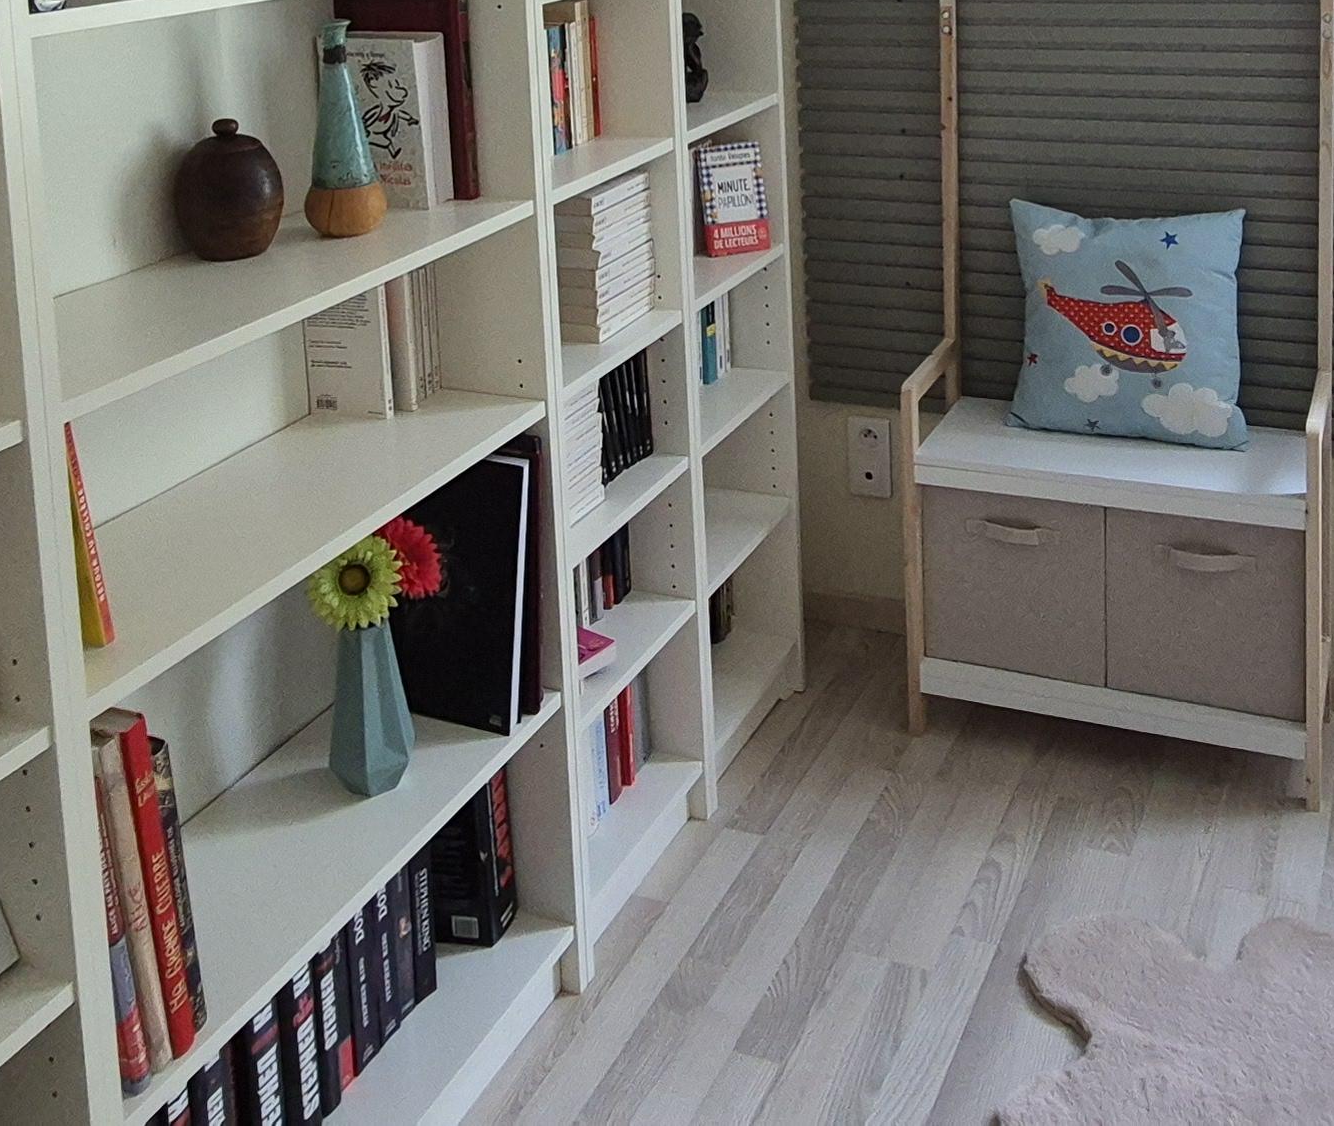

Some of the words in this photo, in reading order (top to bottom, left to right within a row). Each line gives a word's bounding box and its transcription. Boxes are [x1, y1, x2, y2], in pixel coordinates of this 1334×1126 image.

[714, 239, 724, 249] DE
[724, 235, 759, 248] LECTEURS
[720, 224, 757, 239] MILLIONS
[87, 540, 98, 555] AU
[91, 558, 106, 602] RETOUR
[150, 850, 177, 916] GUERRE
[161, 919, 185, 974] GRANDE
[320, 970, 339, 1051] STEPHEN
[296, 1014, 321, 1120] STEPHEN
